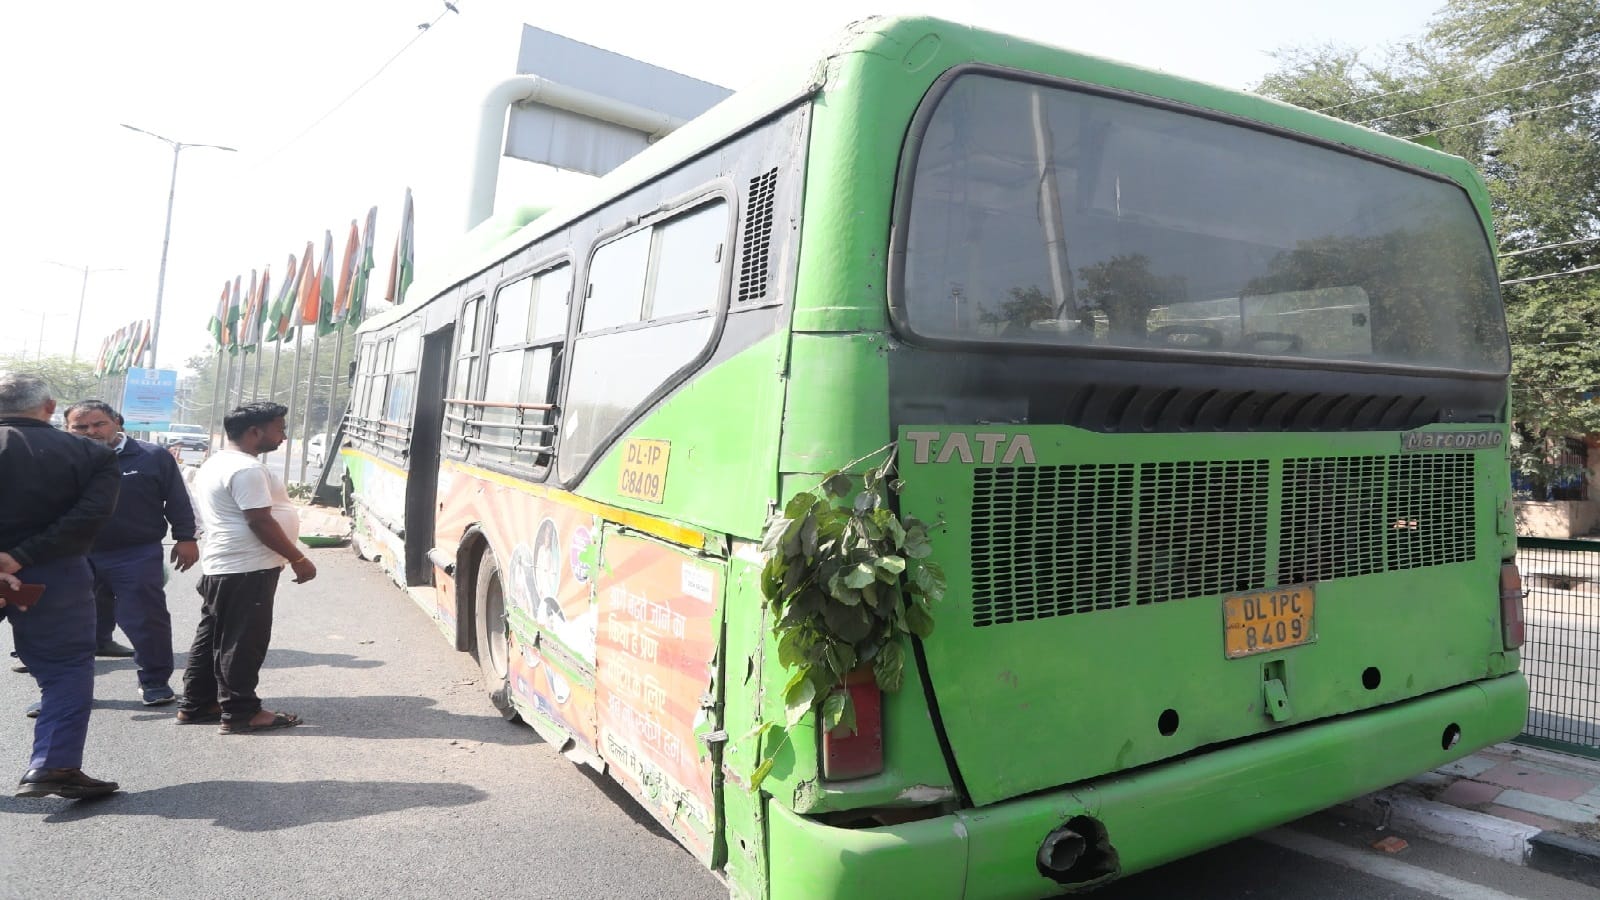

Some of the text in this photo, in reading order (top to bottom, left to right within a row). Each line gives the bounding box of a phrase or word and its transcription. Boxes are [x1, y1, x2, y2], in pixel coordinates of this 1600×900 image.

[906, 431, 1037, 464] TATA
[1407, 430, 1502, 449] Marcopolo
[622, 470, 659, 497] C8409
[648, 600, 671, 632] जाने
[672, 611, 687, 640] का
[1246, 618, 1302, 649] 8409
[643, 673, 667, 715] लिए
[608, 733, 628, 768] दिल्ली
